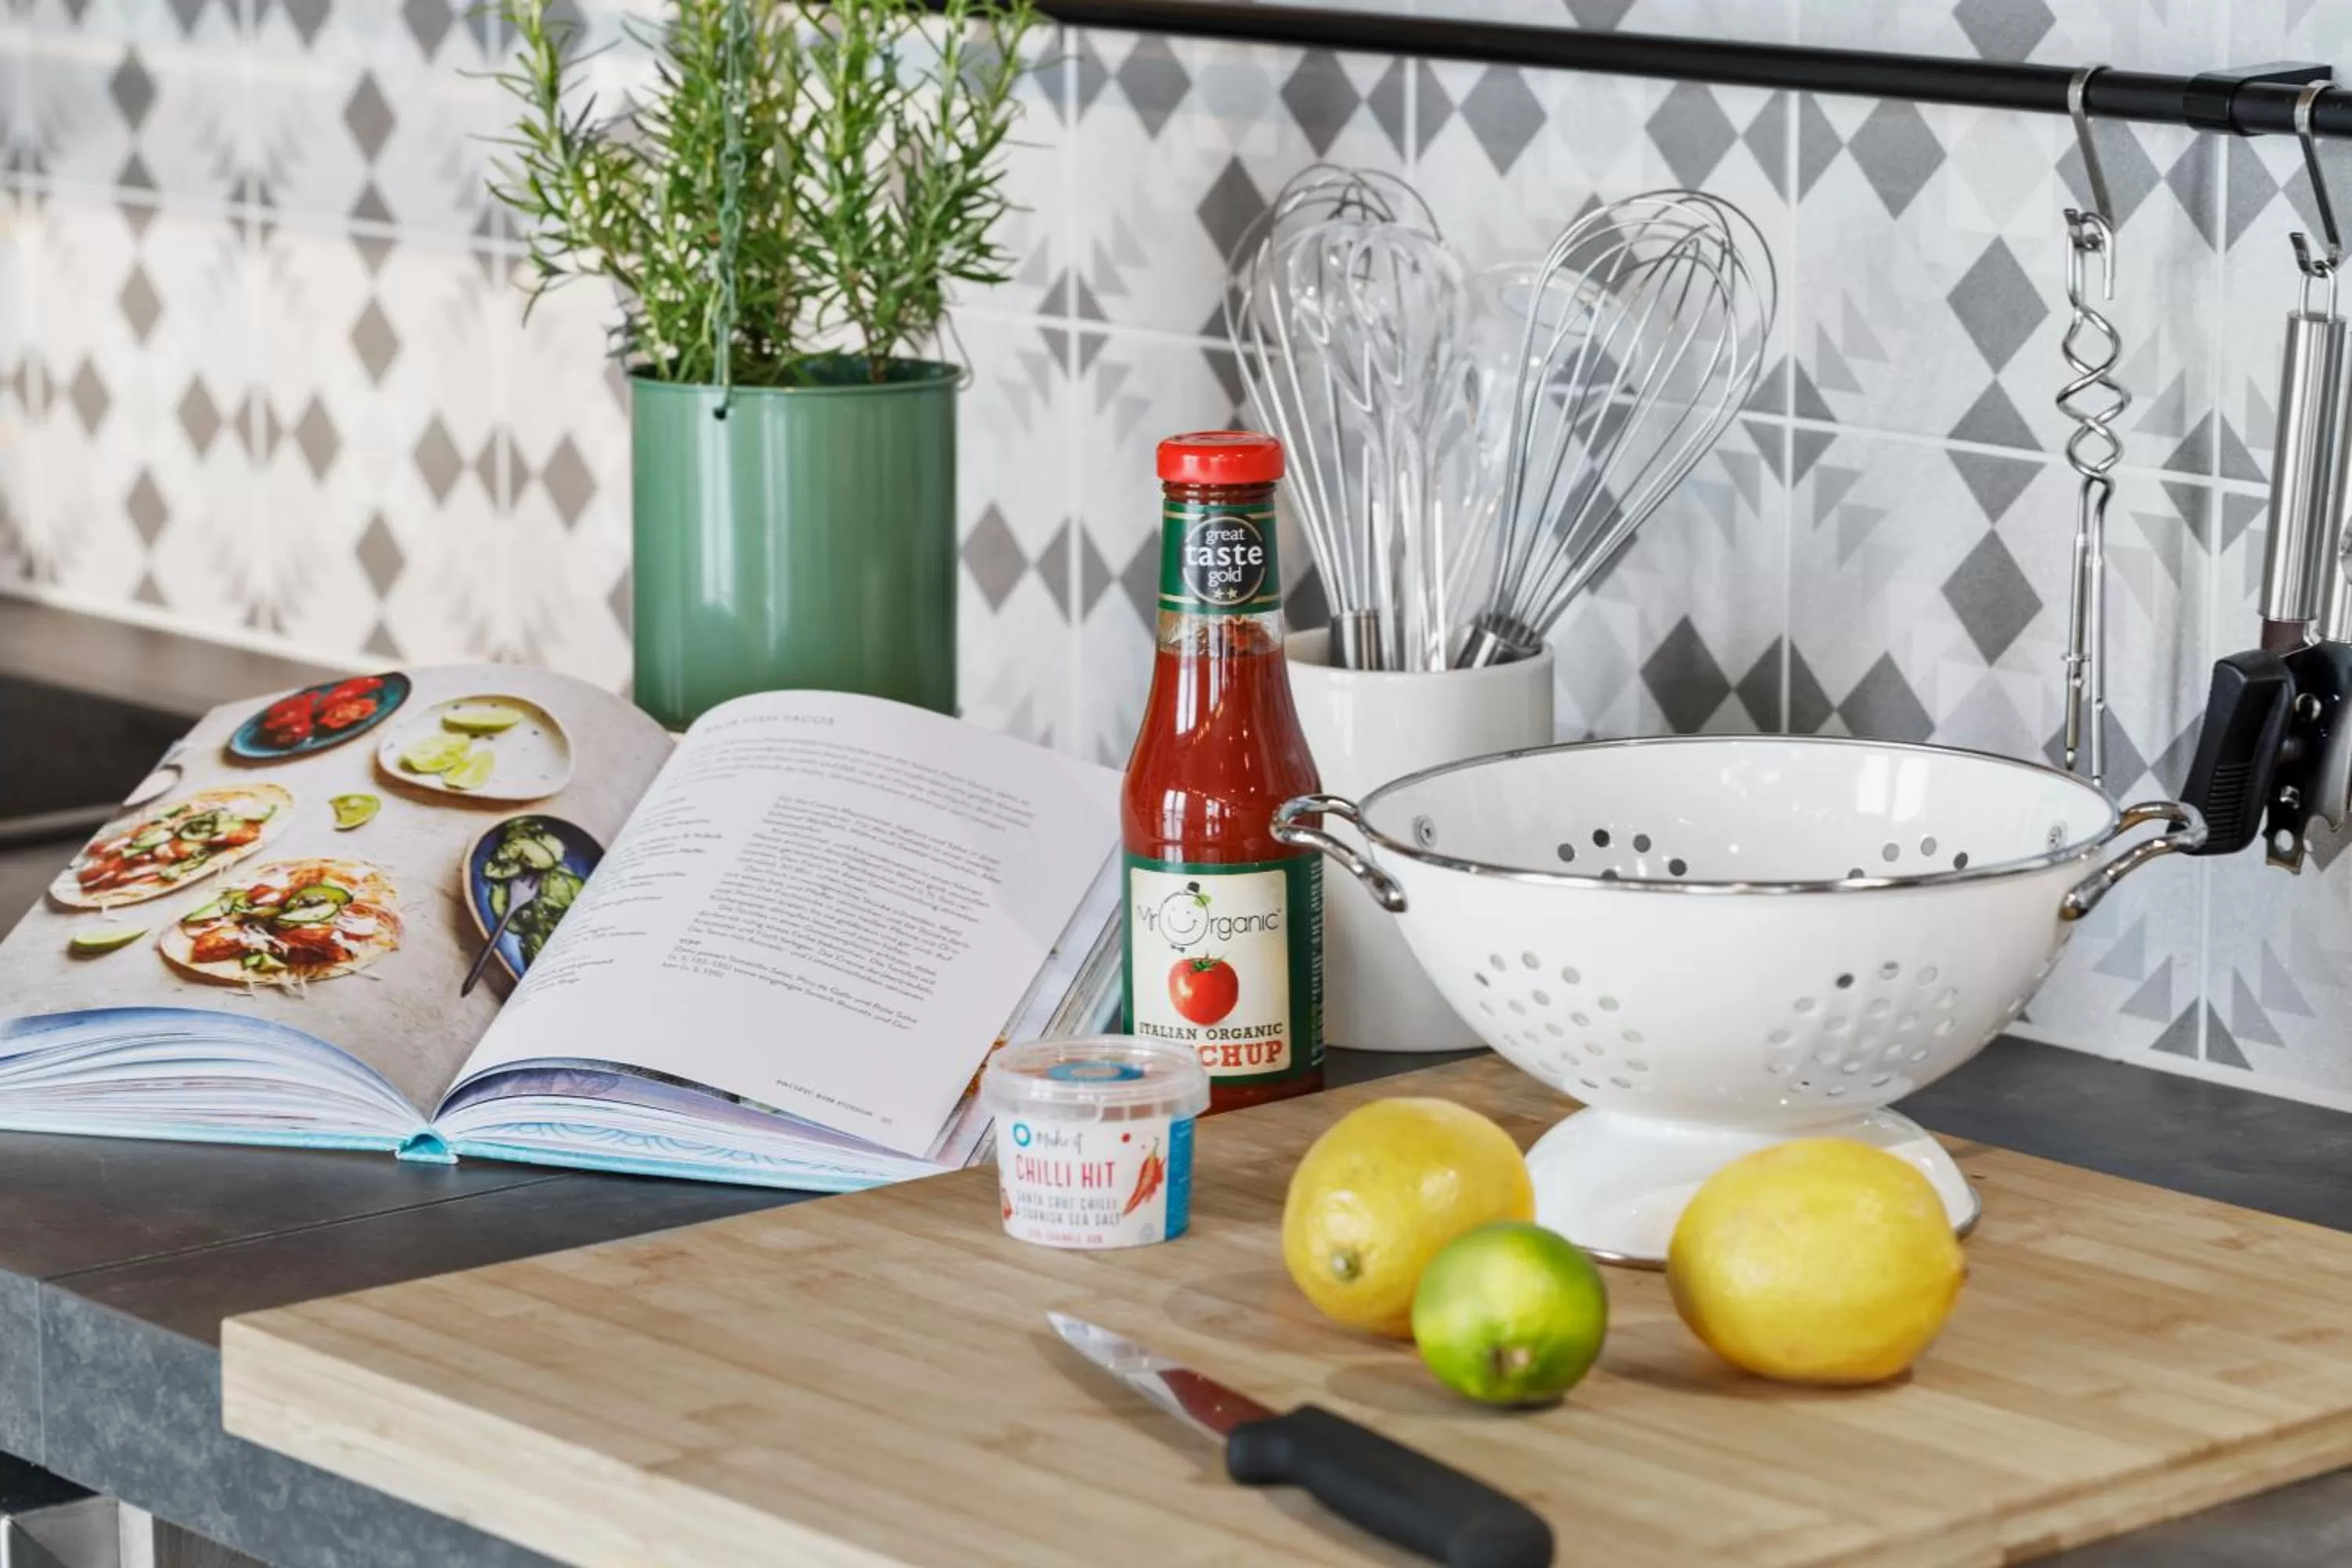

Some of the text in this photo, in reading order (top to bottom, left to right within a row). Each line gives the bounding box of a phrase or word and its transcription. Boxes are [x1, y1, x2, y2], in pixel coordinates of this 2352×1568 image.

[1205, 528, 1245, 545] great
[1185, 543, 1263, 566] taste
[1208, 567, 1242, 586] gold
[1139, 1022, 1283, 1040] ITALIAN ORGANIC
[1198, 1040, 1283, 1068] CHUP
[1015, 1154, 1115, 1189] CHILLI HIT
